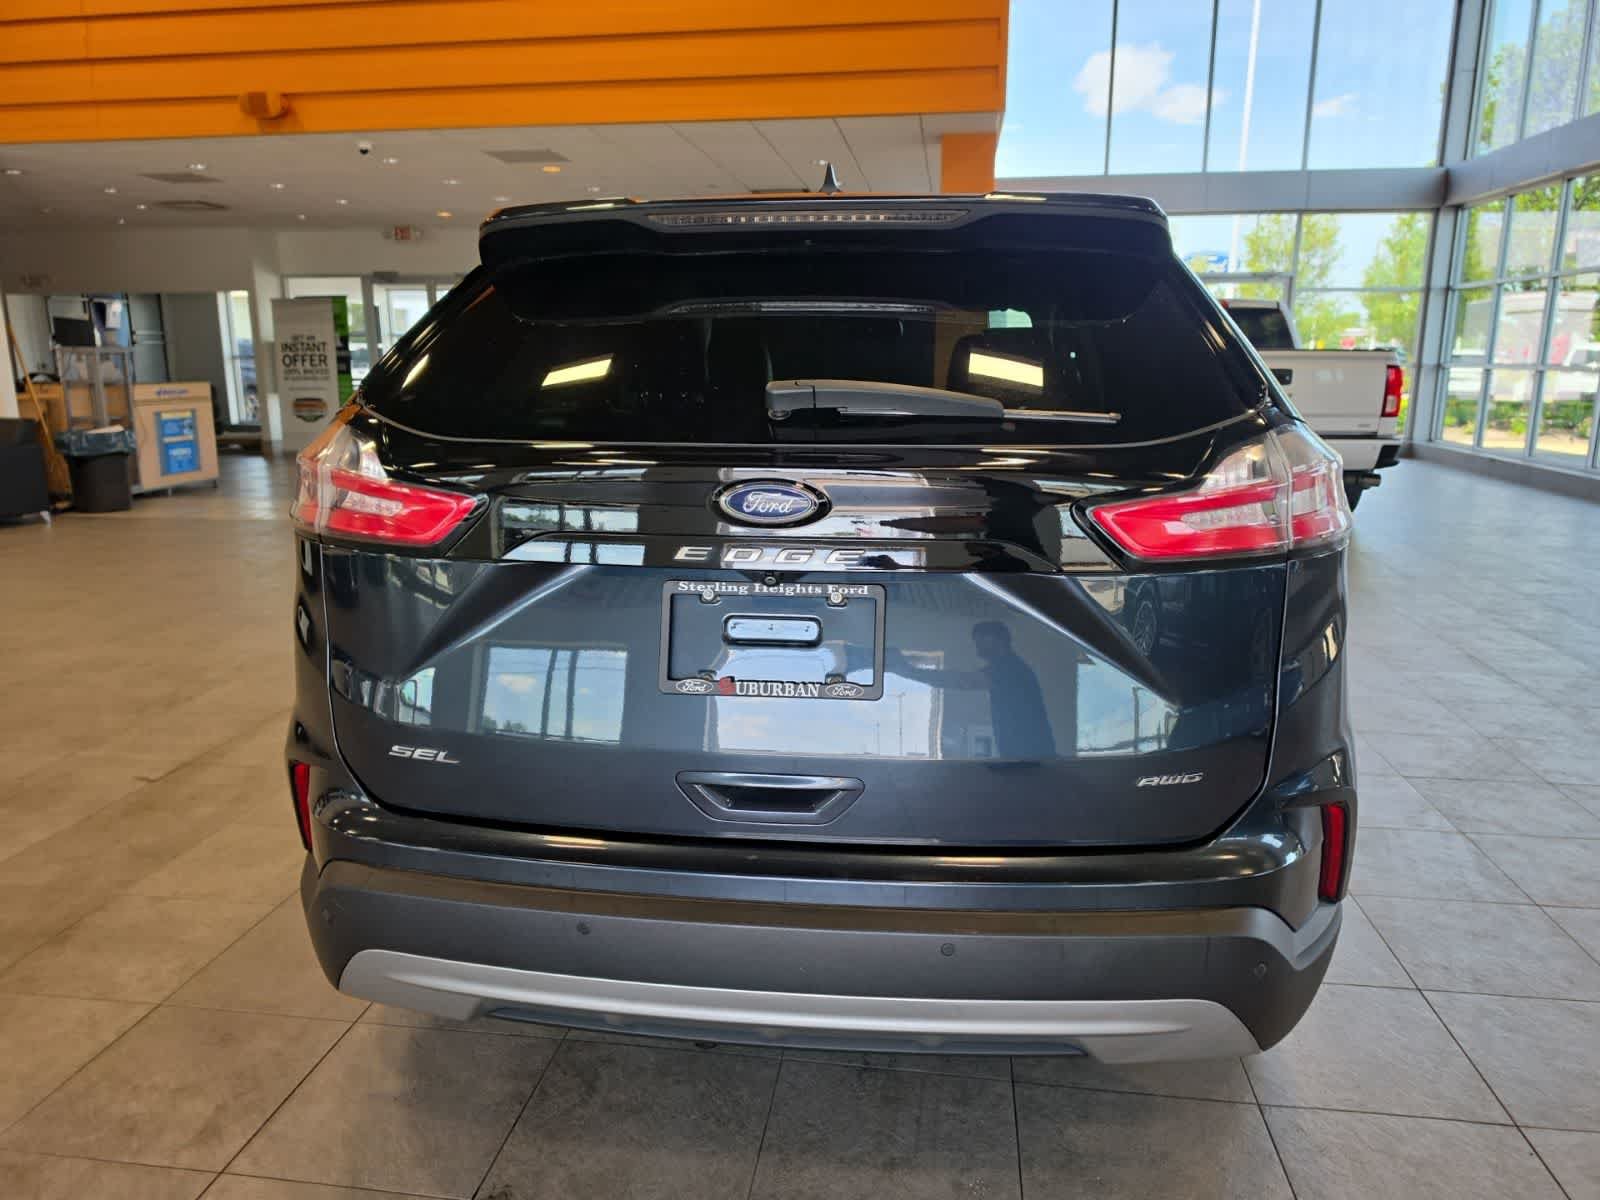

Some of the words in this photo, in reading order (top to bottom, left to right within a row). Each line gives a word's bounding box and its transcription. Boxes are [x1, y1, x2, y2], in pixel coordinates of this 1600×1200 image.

[281, 342, 327, 352] INSTANT
[282, 354, 328, 368] OFFER
[743, 491, 795, 514] Ford
[673, 546, 866, 565] EDGE
[677, 581, 749, 596] Sterling
[754, 583, 823, 596] Heights
[827, 584, 869, 597] Ford
[388, 745, 461, 764] SEL
[1137, 772, 1204, 787] AWD
